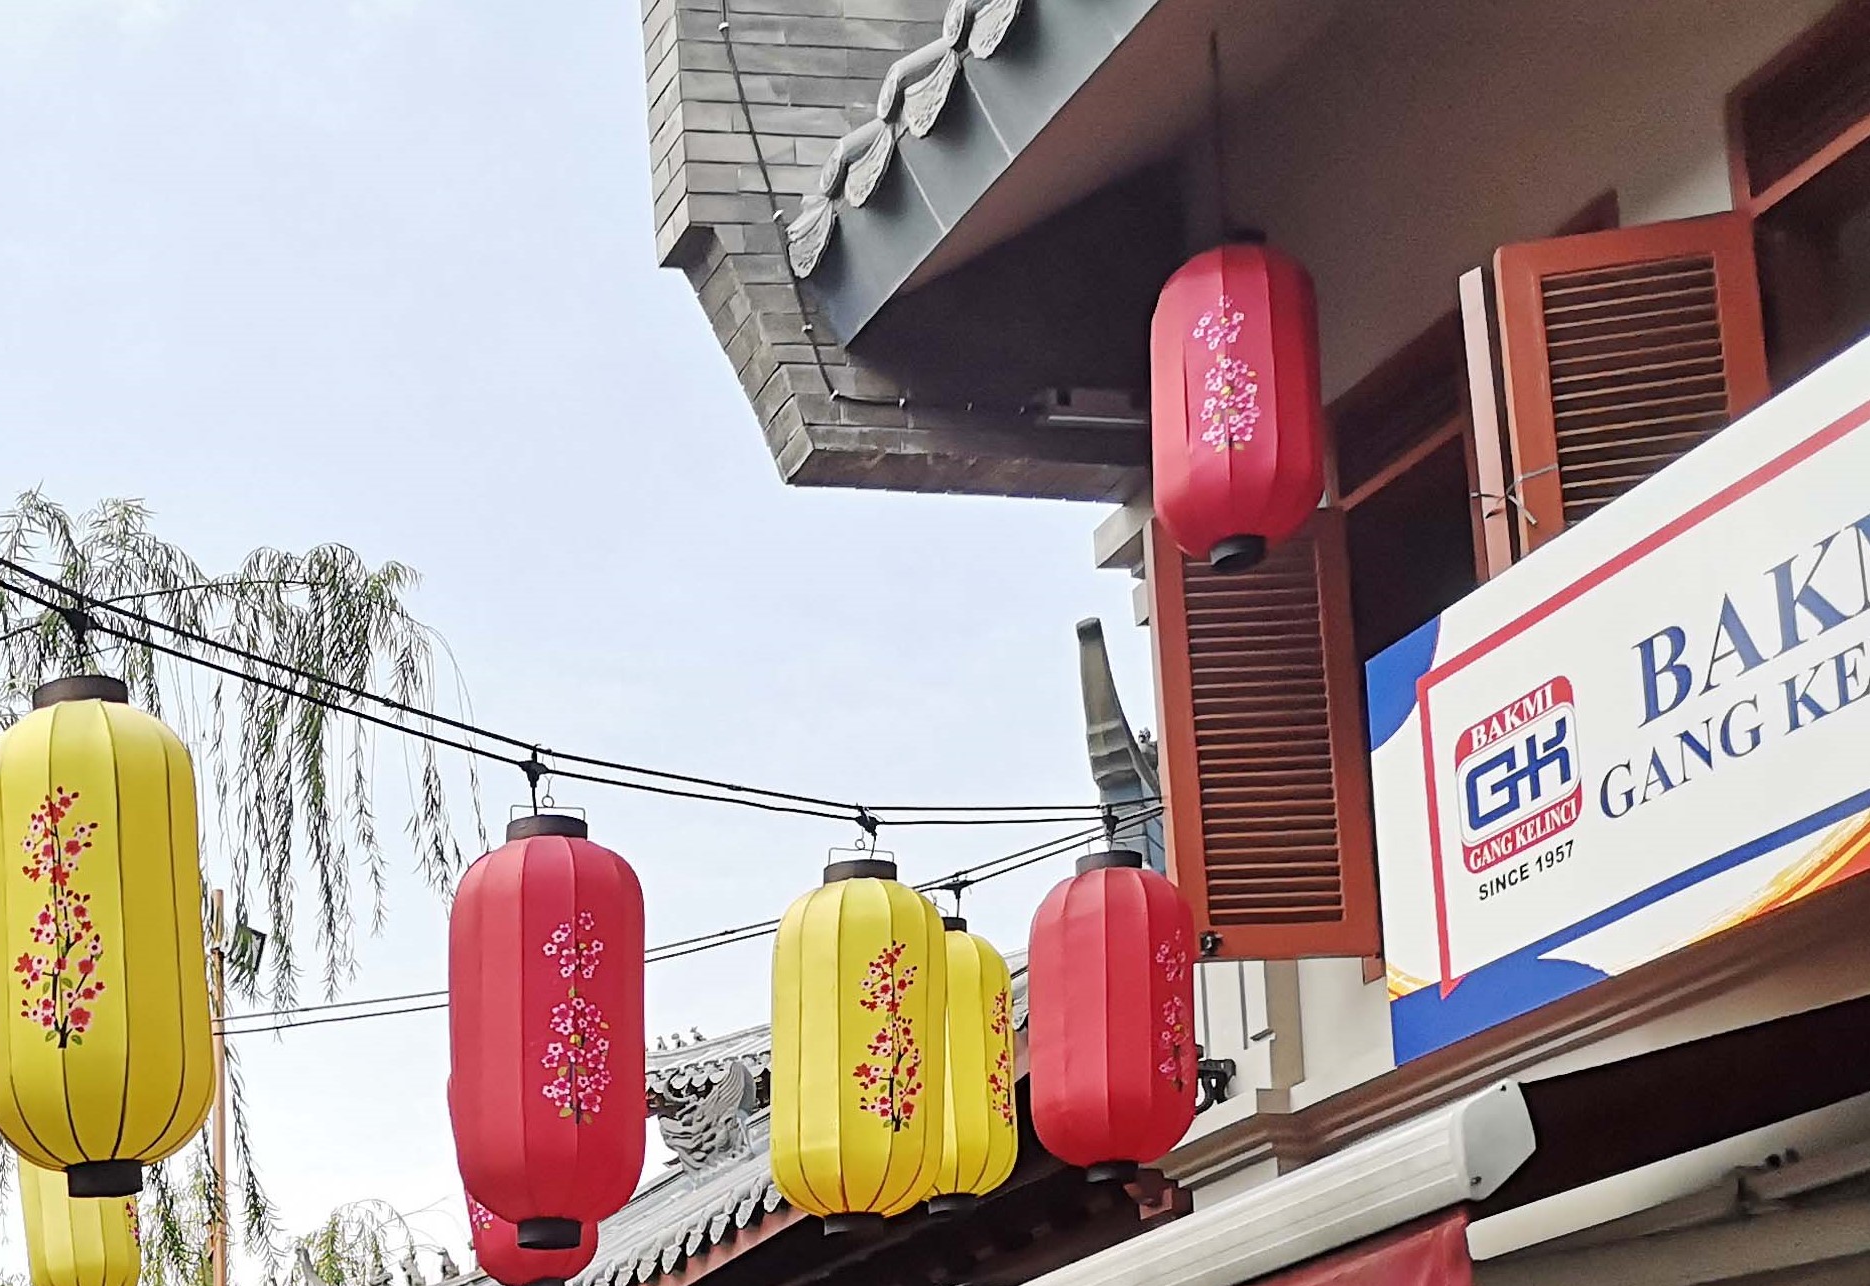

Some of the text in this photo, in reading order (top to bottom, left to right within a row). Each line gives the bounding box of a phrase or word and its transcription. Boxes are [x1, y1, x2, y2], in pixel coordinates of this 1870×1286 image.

[1470, 682, 1554, 752] BAKMI
[1466, 717, 1571, 831] GK
[1599, 694, 1764, 818] GANG
[1469, 798, 1578, 870] GANG KELINCI
[1478, 840, 1574, 901] SINCE 1957
